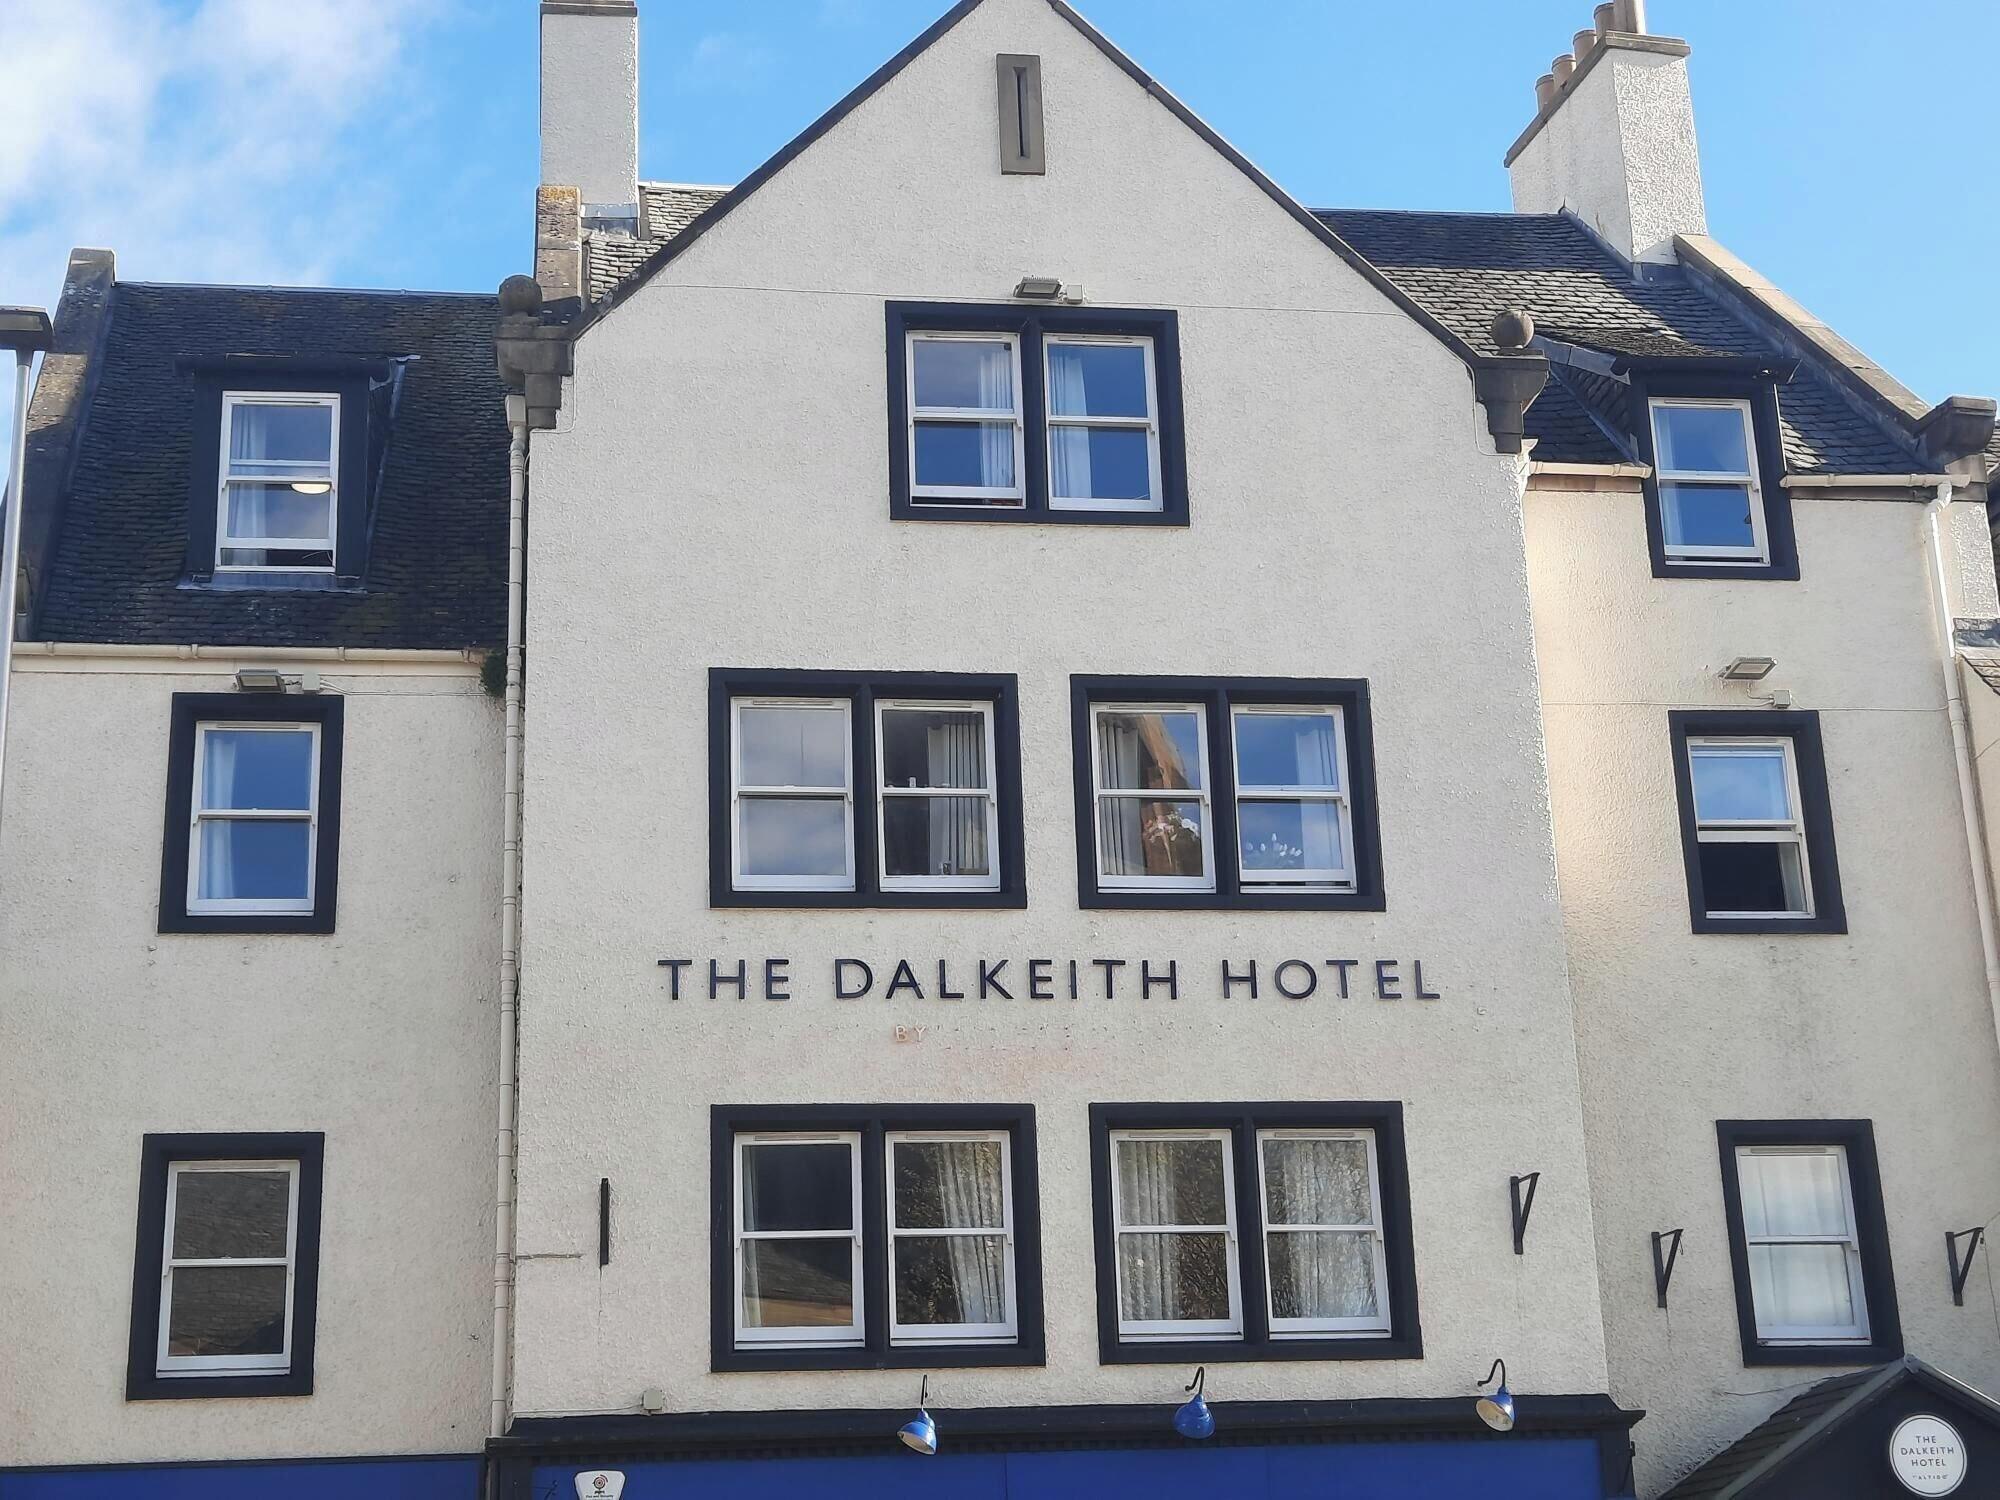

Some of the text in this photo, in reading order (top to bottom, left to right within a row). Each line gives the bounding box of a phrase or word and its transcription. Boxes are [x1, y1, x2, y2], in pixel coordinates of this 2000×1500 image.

[657, 958, 1441, 1001] THE DALKEITH HOTEL
[895, 1024, 927, 1042] BY
[1915, 1435, 1937, 1444] THE
[1900, 1447, 1955, 1456] DALKEITH
[1911, 1459, 1946, 1467] HOTEL
